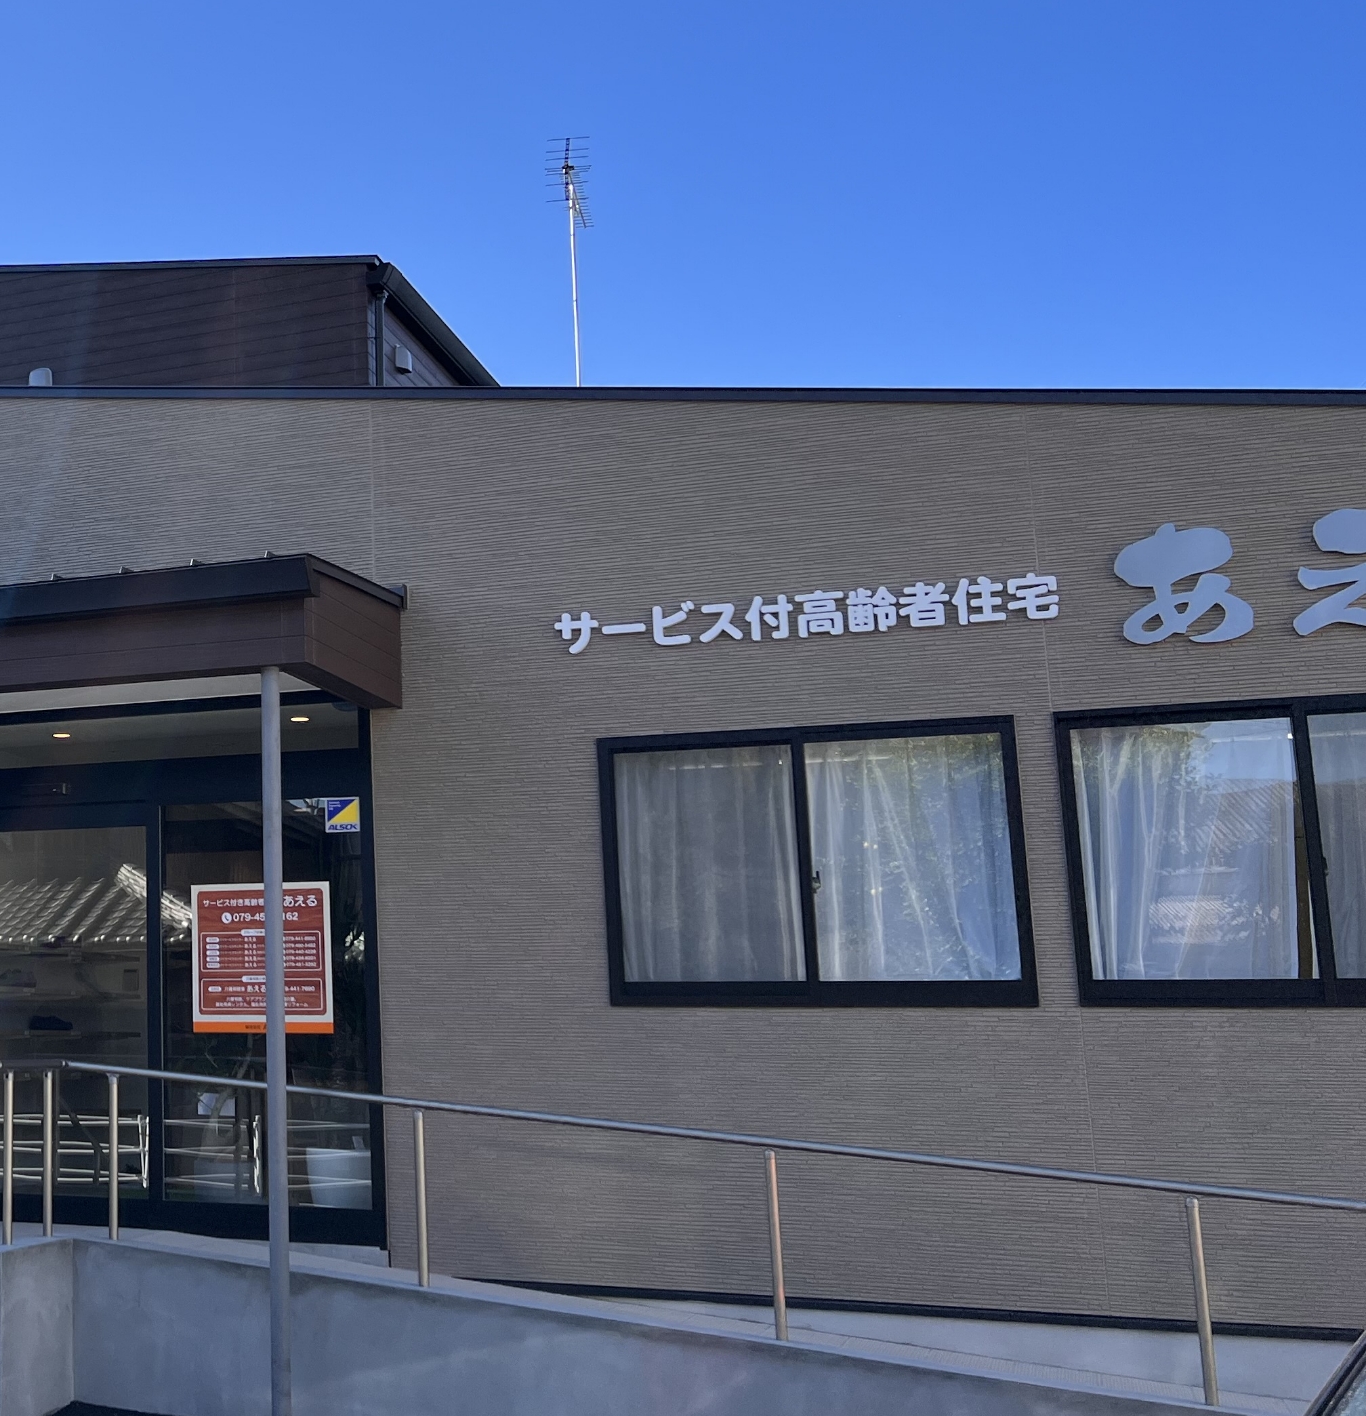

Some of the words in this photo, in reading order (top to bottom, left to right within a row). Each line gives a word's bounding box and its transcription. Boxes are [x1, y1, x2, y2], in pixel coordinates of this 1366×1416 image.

[553, 572, 1060, 654] サービス付高齢者住宅
[203, 898, 264, 908] サービス付き高齢者
[284, 895, 318, 907] あえる
